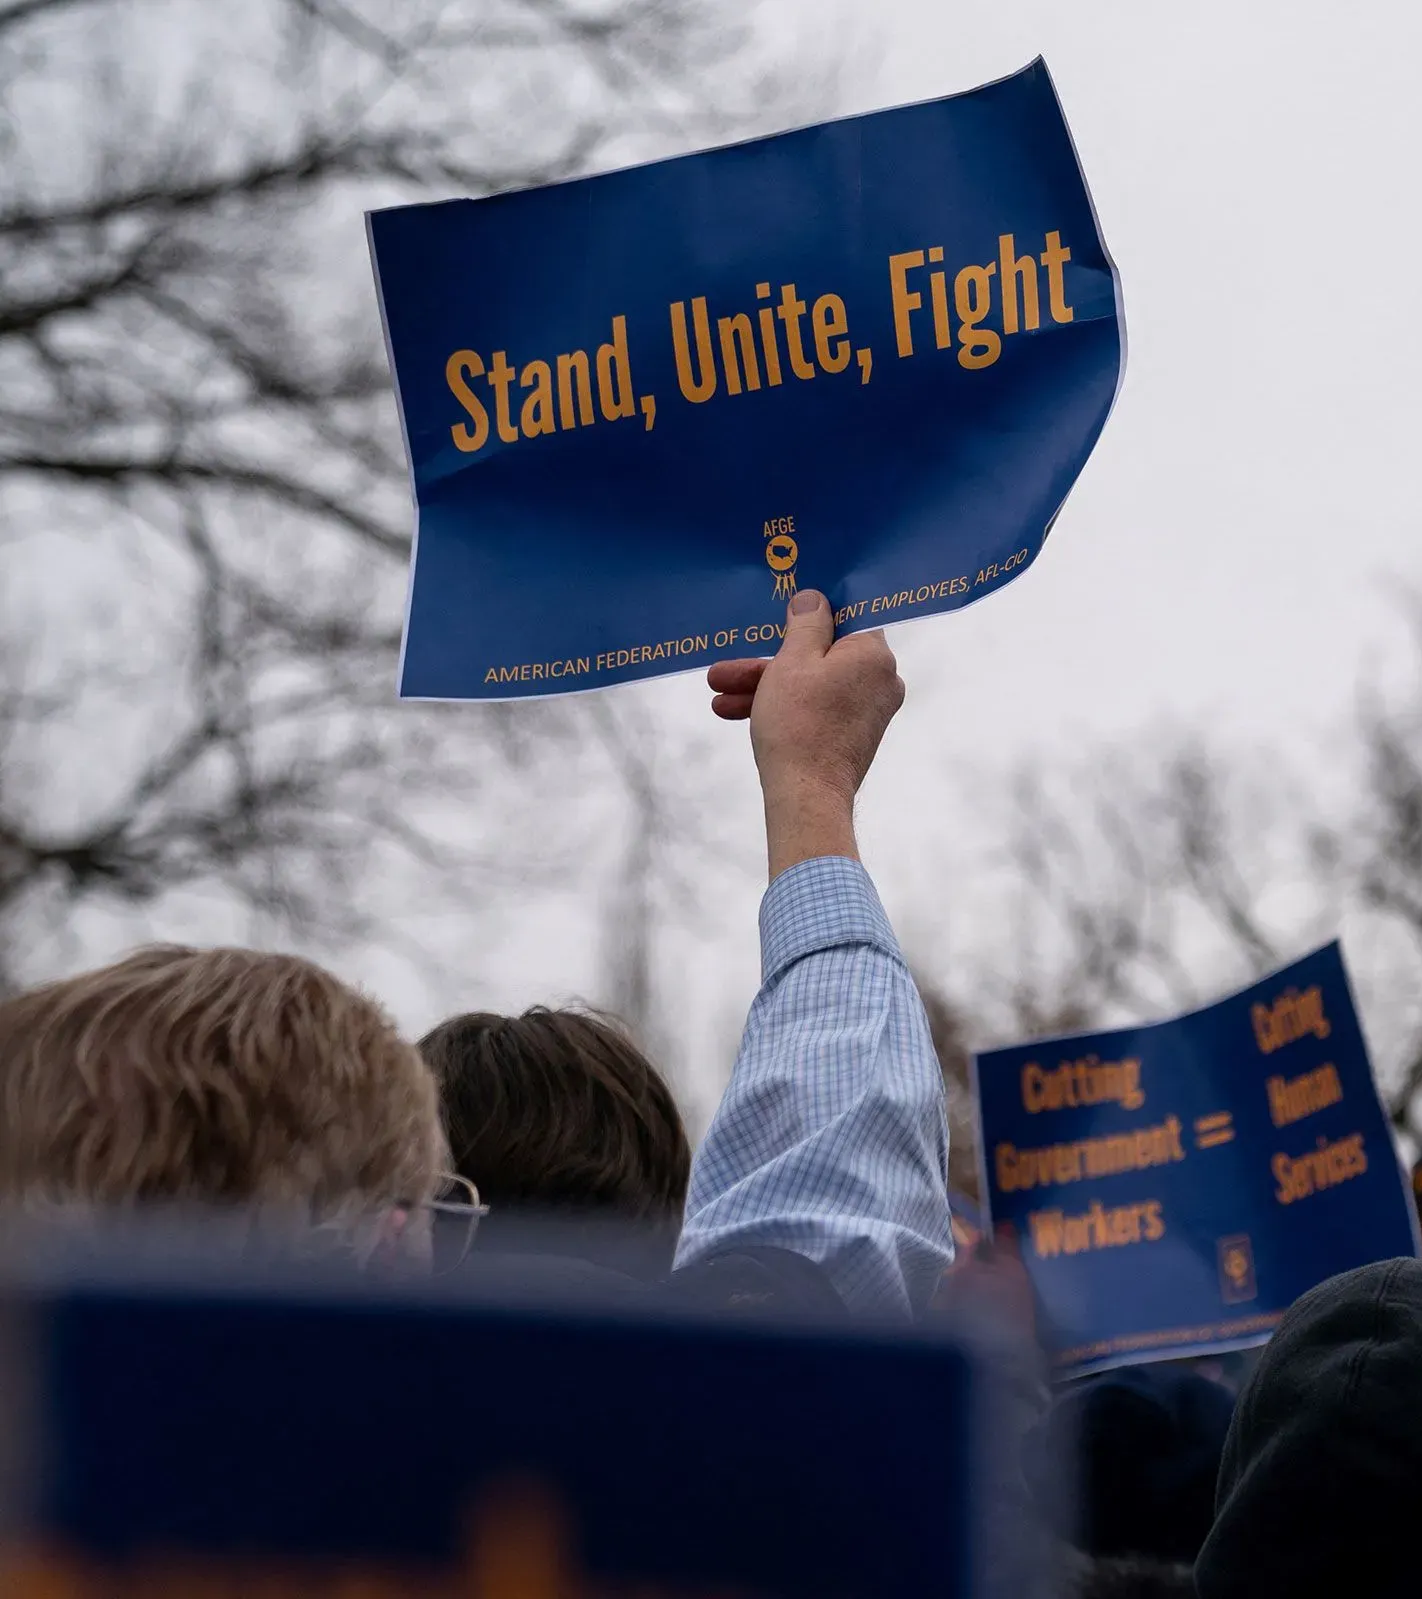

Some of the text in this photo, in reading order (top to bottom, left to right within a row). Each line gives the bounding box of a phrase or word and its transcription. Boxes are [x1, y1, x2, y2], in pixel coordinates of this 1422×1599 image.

[446, 231, 1074, 452] Stand, Unite, Fight
[763, 516, 796, 537] AFGE
[484, 657, 591, 684] AMERICAN
[596, 634, 709, 672] FEDERATION
[714, 629, 740, 648] OF
[871, 576, 971, 613] EMPLOYEES,
[975, 548, 1029, 586] AFL-CIO
[1021, 1055, 1145, 1114] Cutting
[1268, 1064, 1342, 1126] Human
[996, 1117, 1184, 1191] Government
[1272, 1134, 1367, 1204] Services
[1030, 1201, 1164, 1256] Workers
